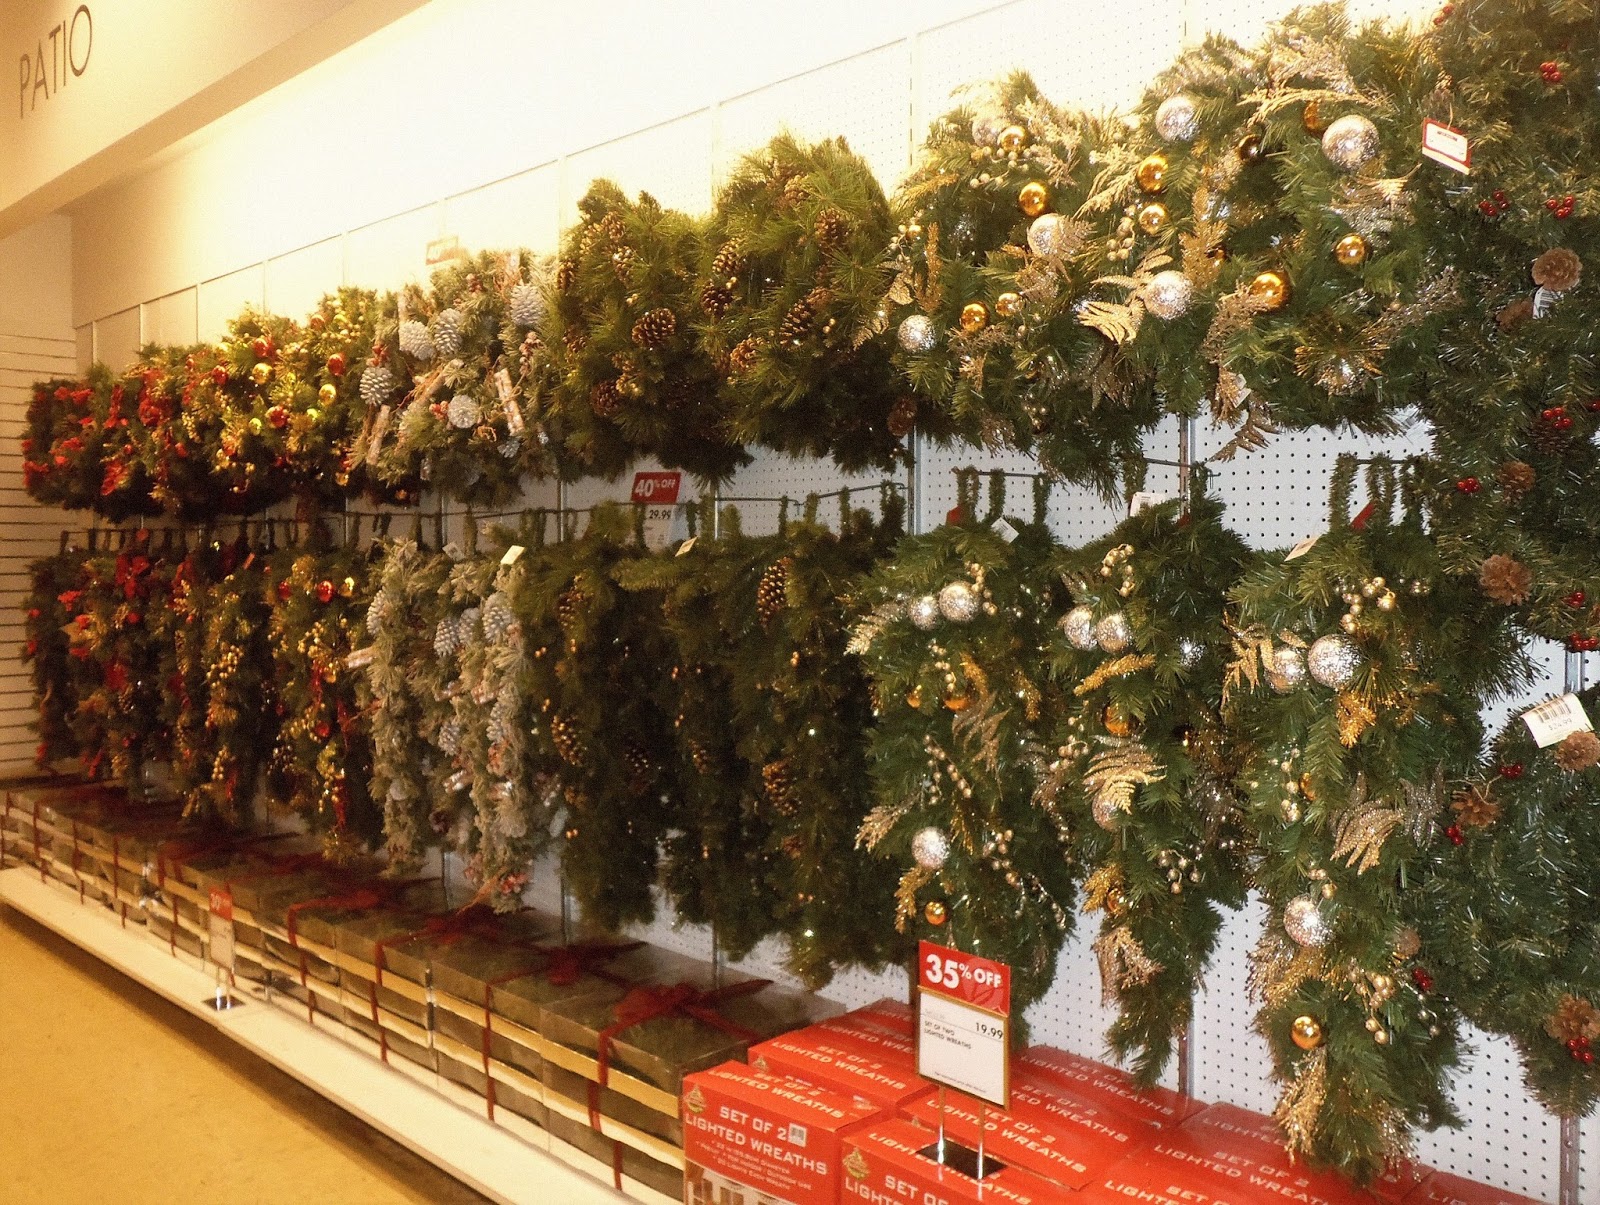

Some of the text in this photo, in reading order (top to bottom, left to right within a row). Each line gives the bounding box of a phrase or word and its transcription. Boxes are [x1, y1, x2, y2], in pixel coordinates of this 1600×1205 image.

[20, 4, 92, 119] PATIO
[661, 479, 676, 488] OFF
[649, 509, 671, 519] 29.99
[926, 953, 1002, 989] 35% OFF
[975, 1021, 1004, 1039] 19.99
[771, 1041, 833, 1063] LIGHTED
[835, 1060, 906, 1090] WREATHS
[816, 1045, 846, 1056] SET
[847, 1054, 869, 1064] OF
[708, 1070, 845, 1119] LIGHTED WREATHS
[753, 1073, 783, 1084] SET
[784, 1081, 808, 1091] OF
[1021, 1056, 1174, 1116] LIGHTED WREATHS
[1021, 1085, 1054, 1098] SET
[1056, 1097, 1083, 1108] OF
[719, 1105, 788, 1141] SET OF 2
[1014, 1121, 1041, 1134] OF
[1045, 1103, 1130, 1144] WREATHS
[685, 1113, 746, 1145] LIGHTED
[750, 1138, 828, 1176] WREATHS
[1001, 1128, 1087, 1173] WREATHS
[1154, 1144, 1242, 1178] LIGHTED
[1213, 1151, 1254, 1167] SET
[1259, 1165, 1290, 1178] OF
[884, 1174, 919, 1199] SET
[1165, 1185, 1210, 1203] SET
